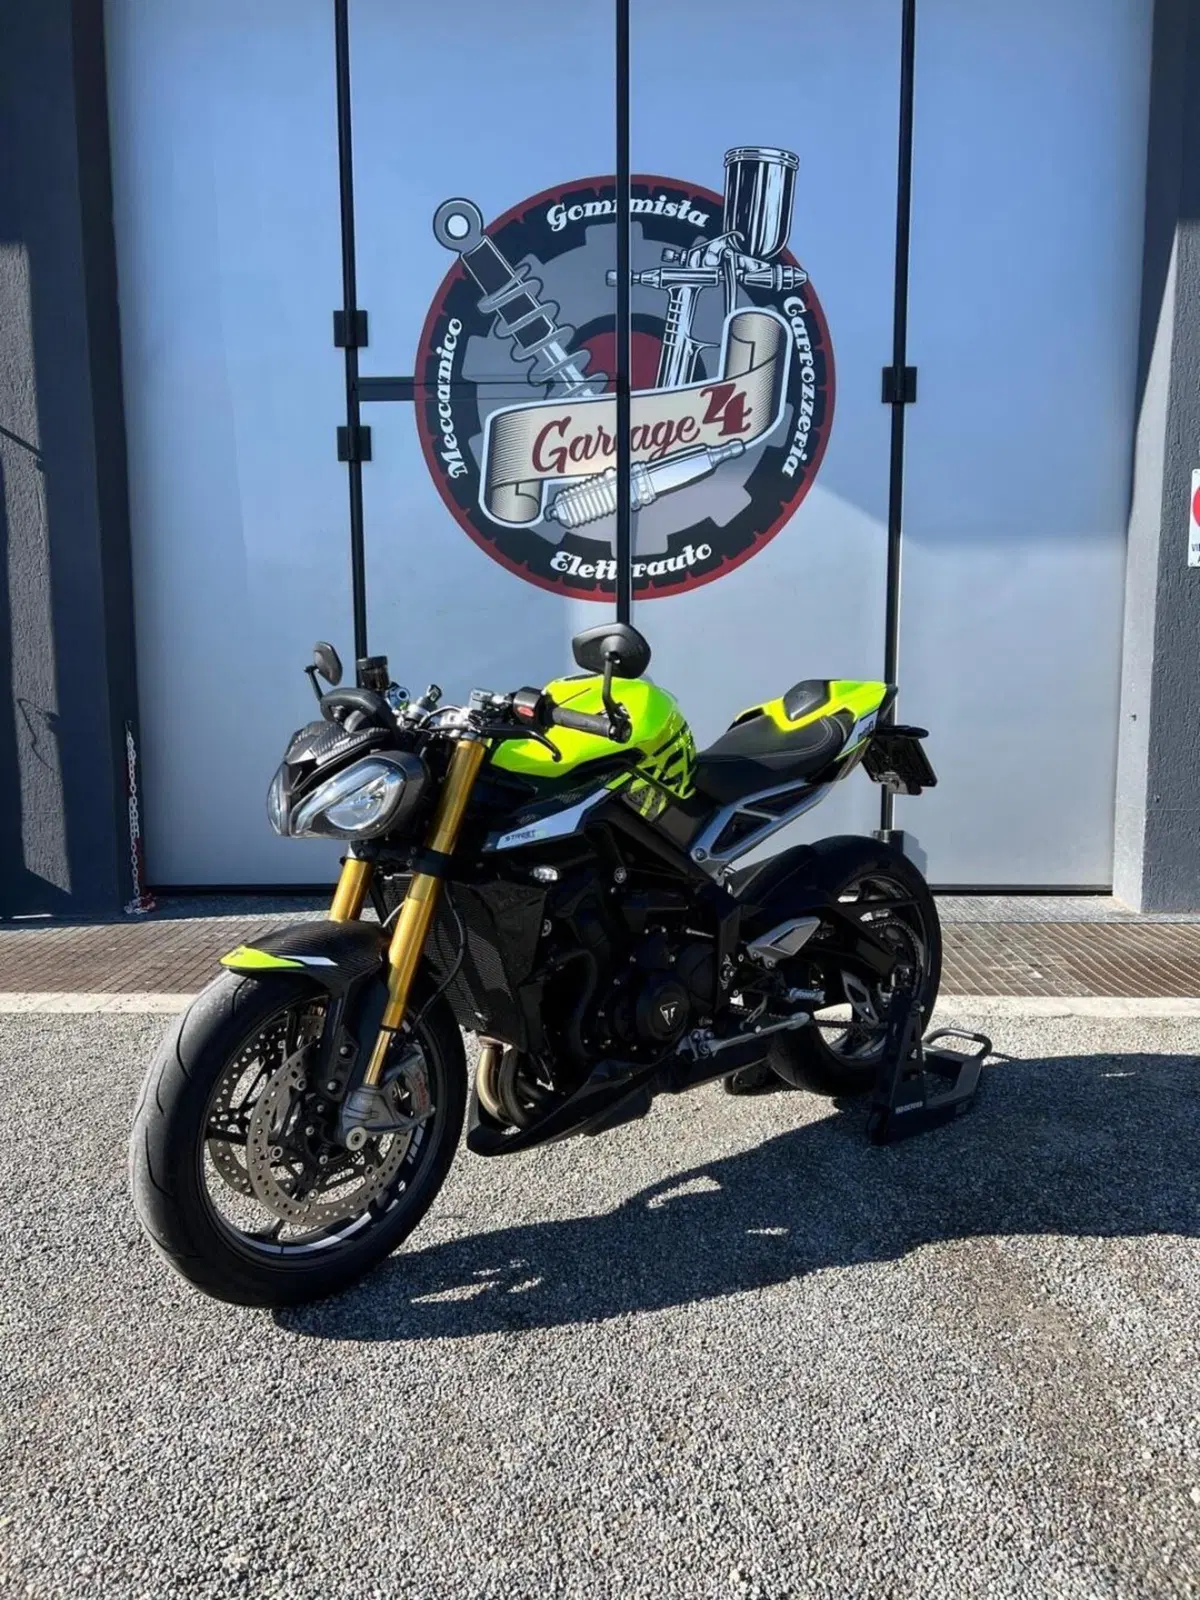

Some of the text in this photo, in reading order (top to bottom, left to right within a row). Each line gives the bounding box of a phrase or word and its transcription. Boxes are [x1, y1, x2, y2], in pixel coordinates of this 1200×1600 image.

[546, 194, 710, 232] Gommista
[436, 317, 469, 480] Meccanico
[531, 382, 753, 474] Garage 4
[781, 295, 816, 478] Carrozzeria
[550, 543, 712, 581] Elettrauto
